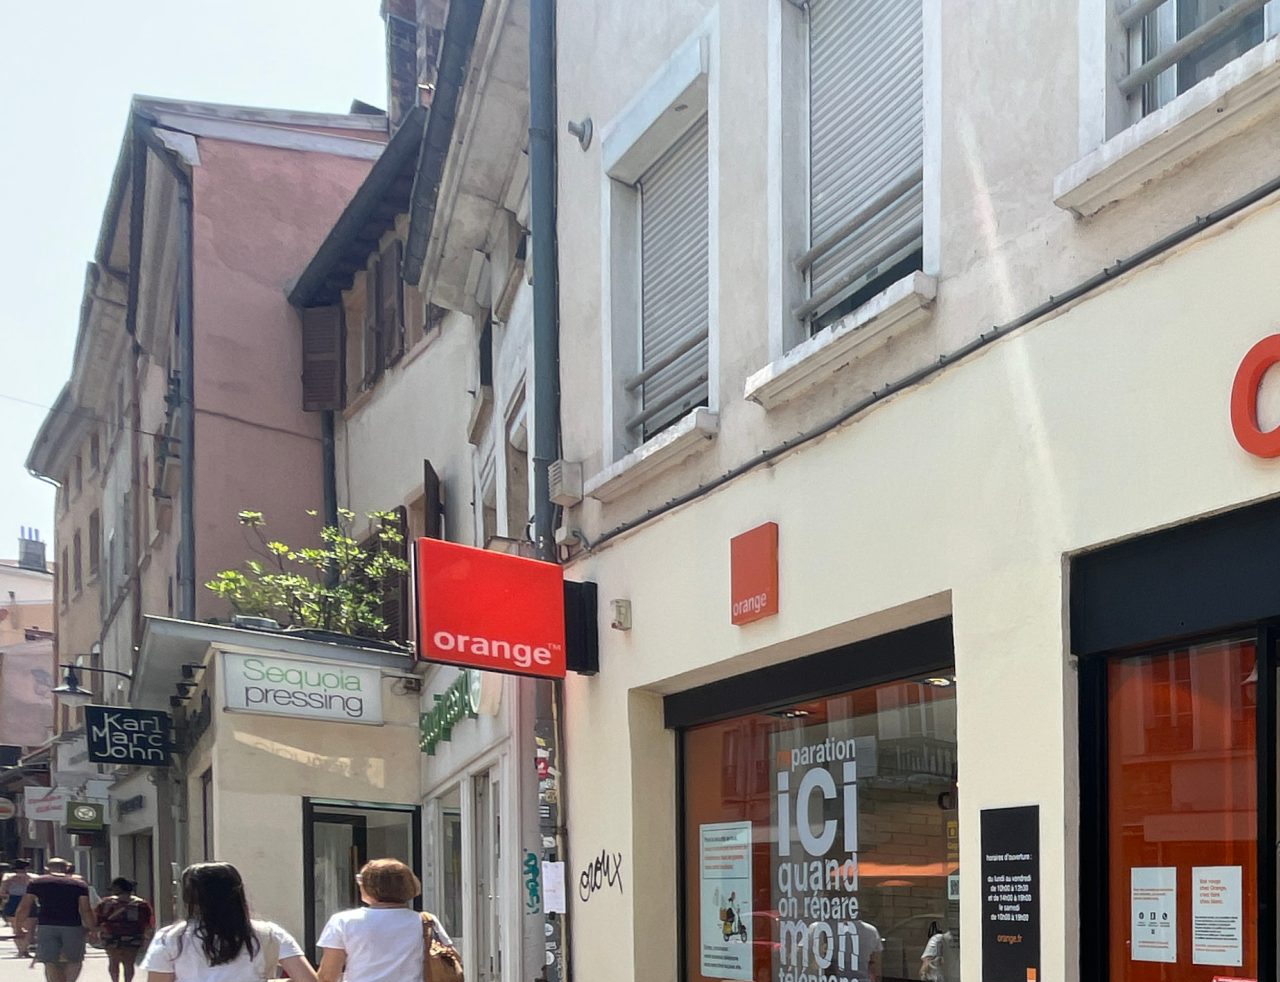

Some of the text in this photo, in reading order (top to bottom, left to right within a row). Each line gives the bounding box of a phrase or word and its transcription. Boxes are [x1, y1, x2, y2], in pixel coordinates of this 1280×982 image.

[733, 592, 768, 617] orange
[243, 658, 362, 693] Sequoia
[245, 686, 363, 718] pressing
[92, 725, 162, 746] Marc
[103, 712, 163, 734] Karl
[95, 742, 164, 761] John
[791, 736, 856, 773] paration
[778, 852, 858, 898] quand
[778, 890, 859, 921] on répare
[779, 919, 860, 972] mon
